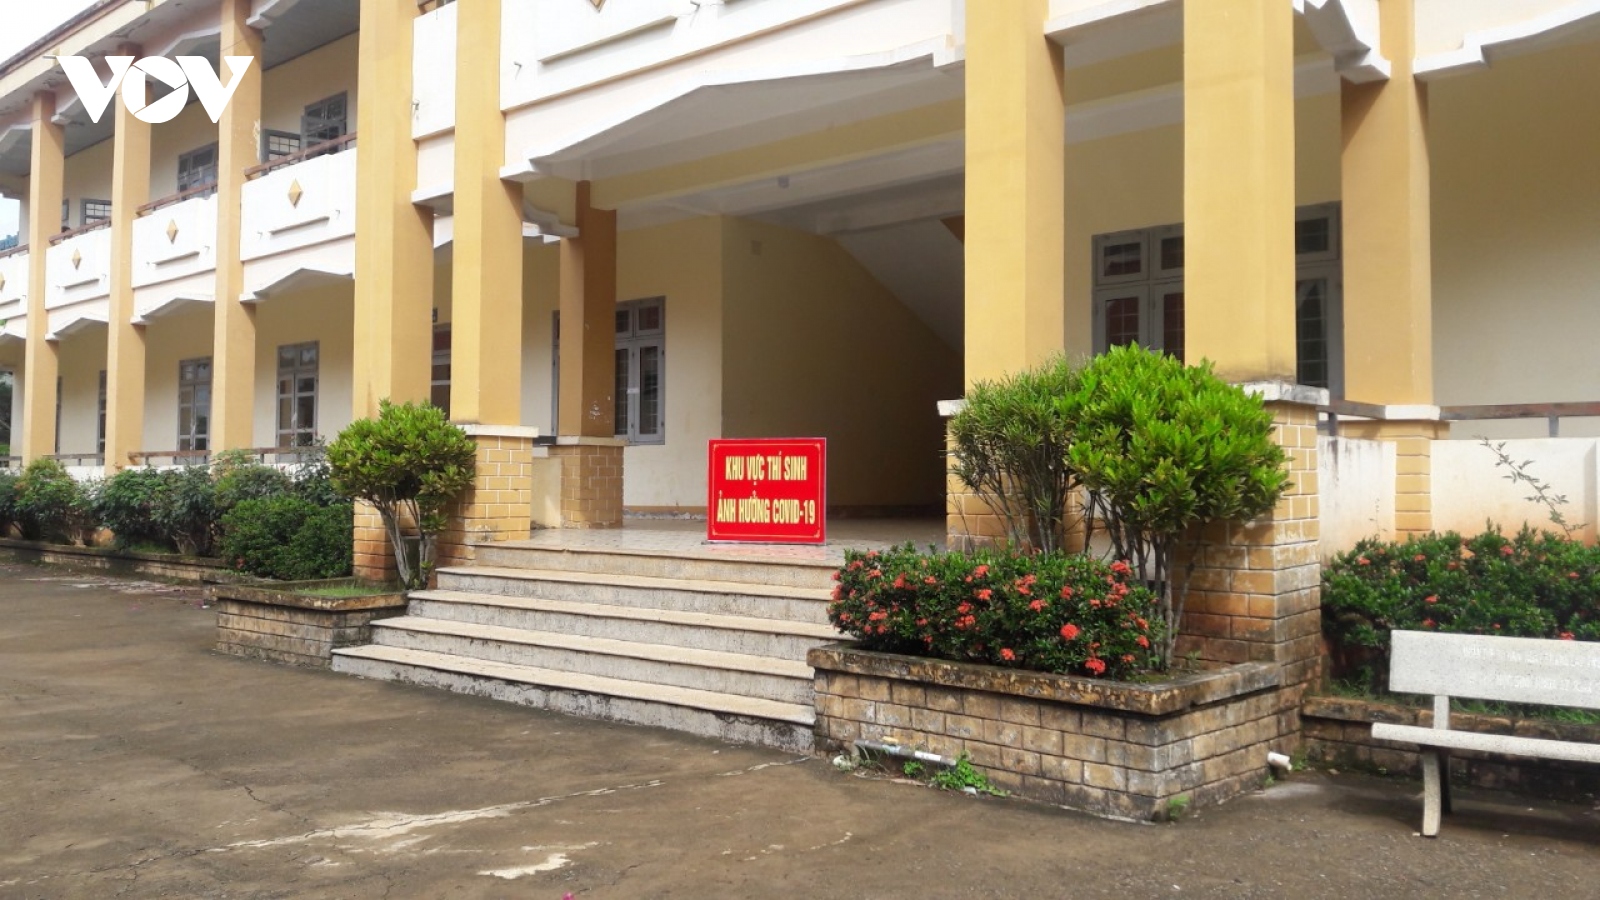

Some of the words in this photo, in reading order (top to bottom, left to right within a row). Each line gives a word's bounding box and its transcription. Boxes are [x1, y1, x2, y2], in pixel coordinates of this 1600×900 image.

[725, 455, 744, 480] KHU
[746, 453, 764, 486] VỰC
[767, 450, 781, 480] THÍ
[784, 455, 807, 480] SINH
[717, 489, 736, 522] ẢNH
[739, 489, 770, 523] HƯỞNG
[772, 499, 815, 524] COVID-19
